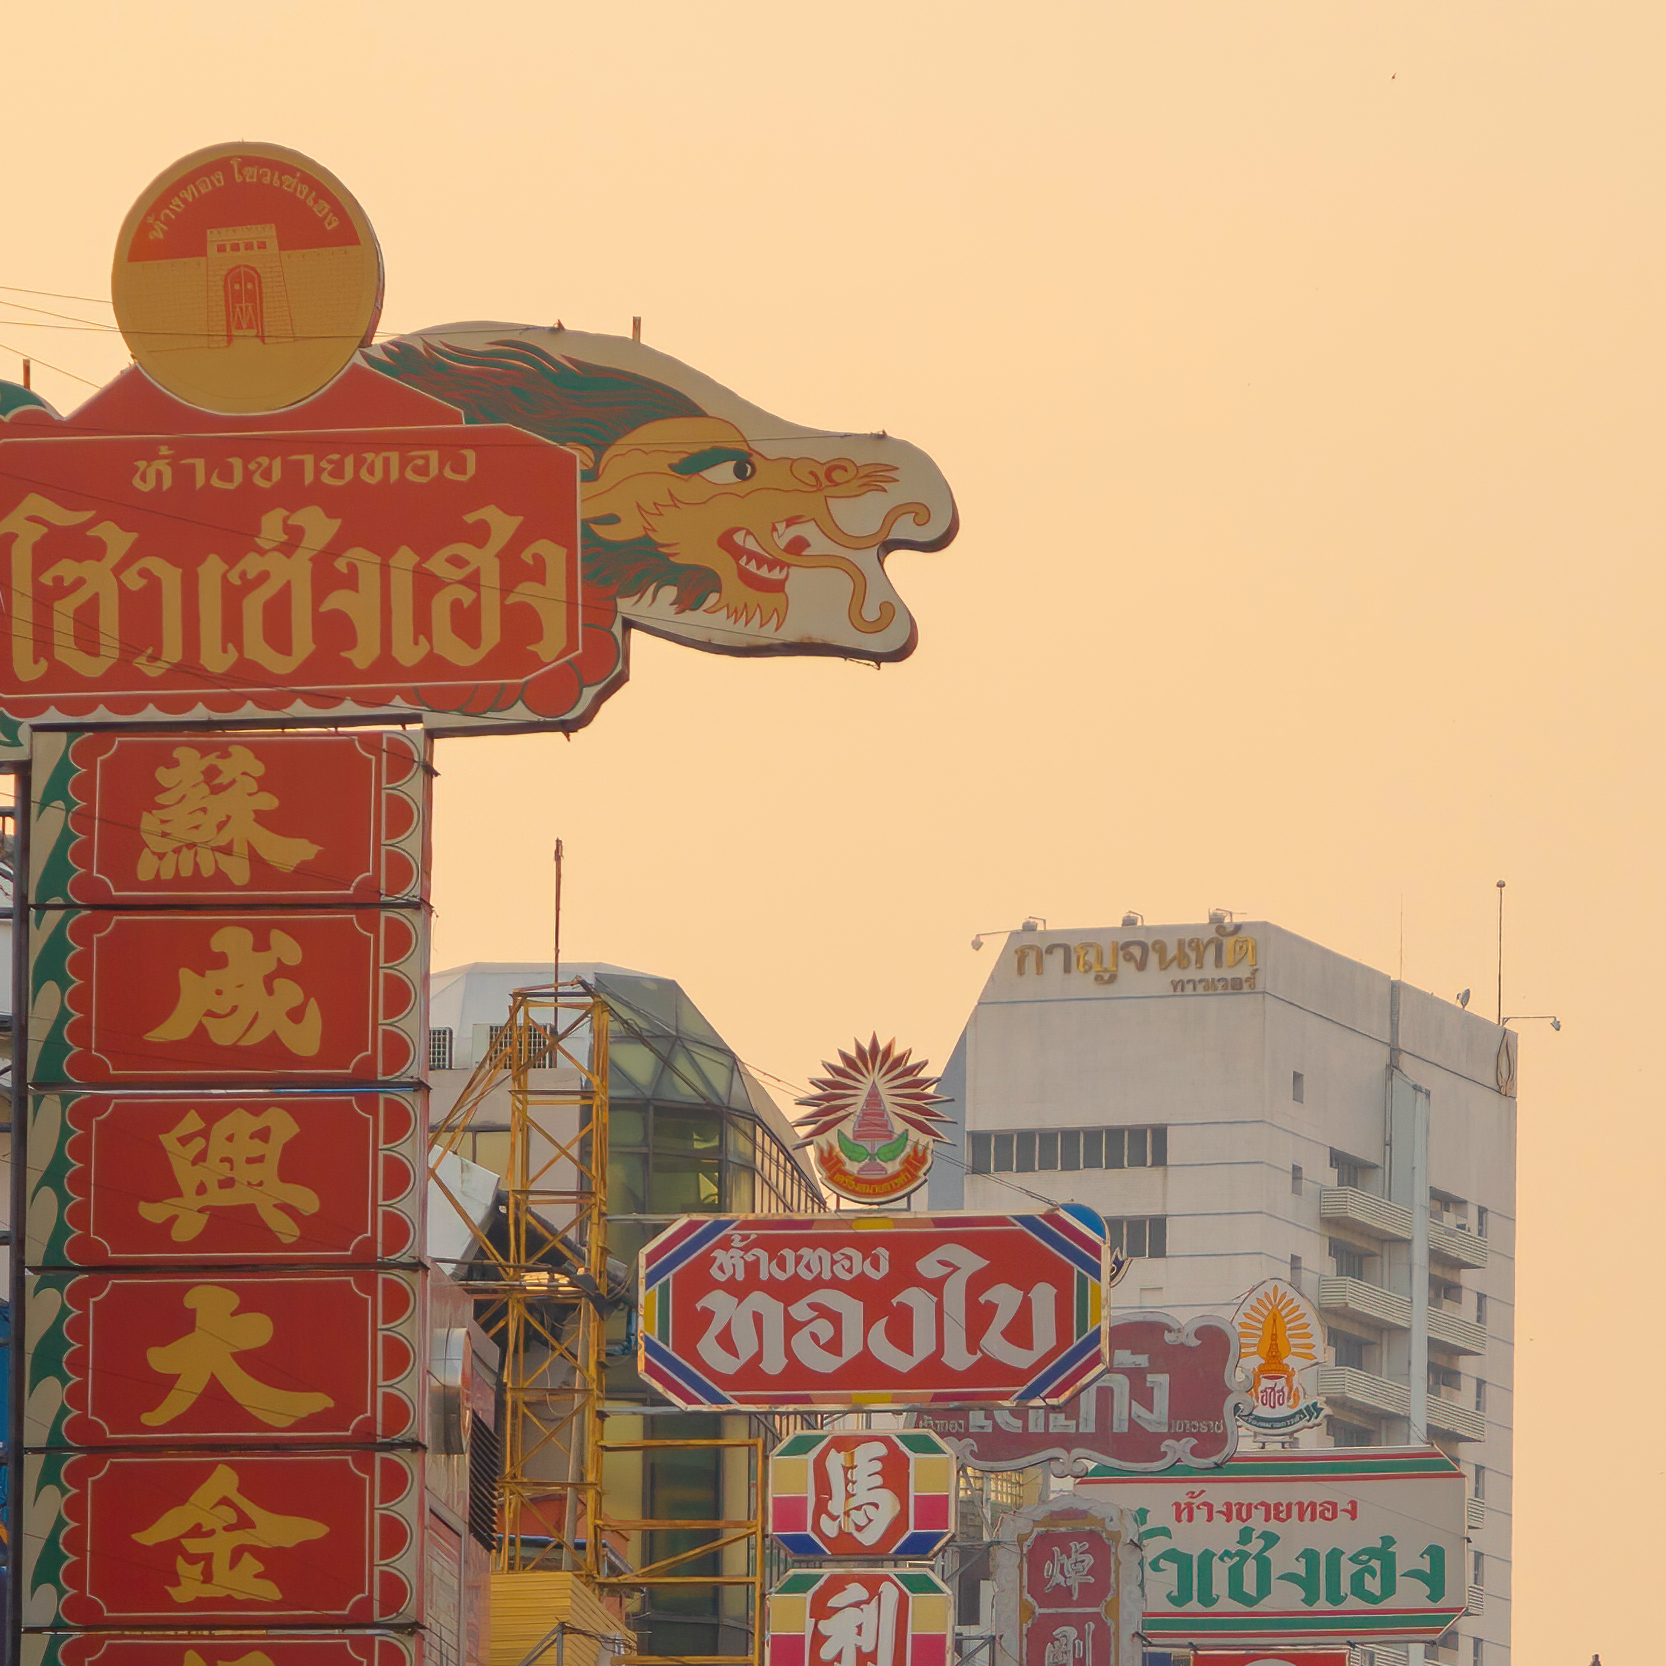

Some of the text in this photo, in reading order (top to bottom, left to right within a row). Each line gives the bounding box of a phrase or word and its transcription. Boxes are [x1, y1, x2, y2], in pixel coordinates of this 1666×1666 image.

[131, 444, 477, 494] ห้างขายทอง
[709, 1233, 890, 1282] ห้างทอง
[1171, 1488, 1359, 1524] ห้างขายทอง
